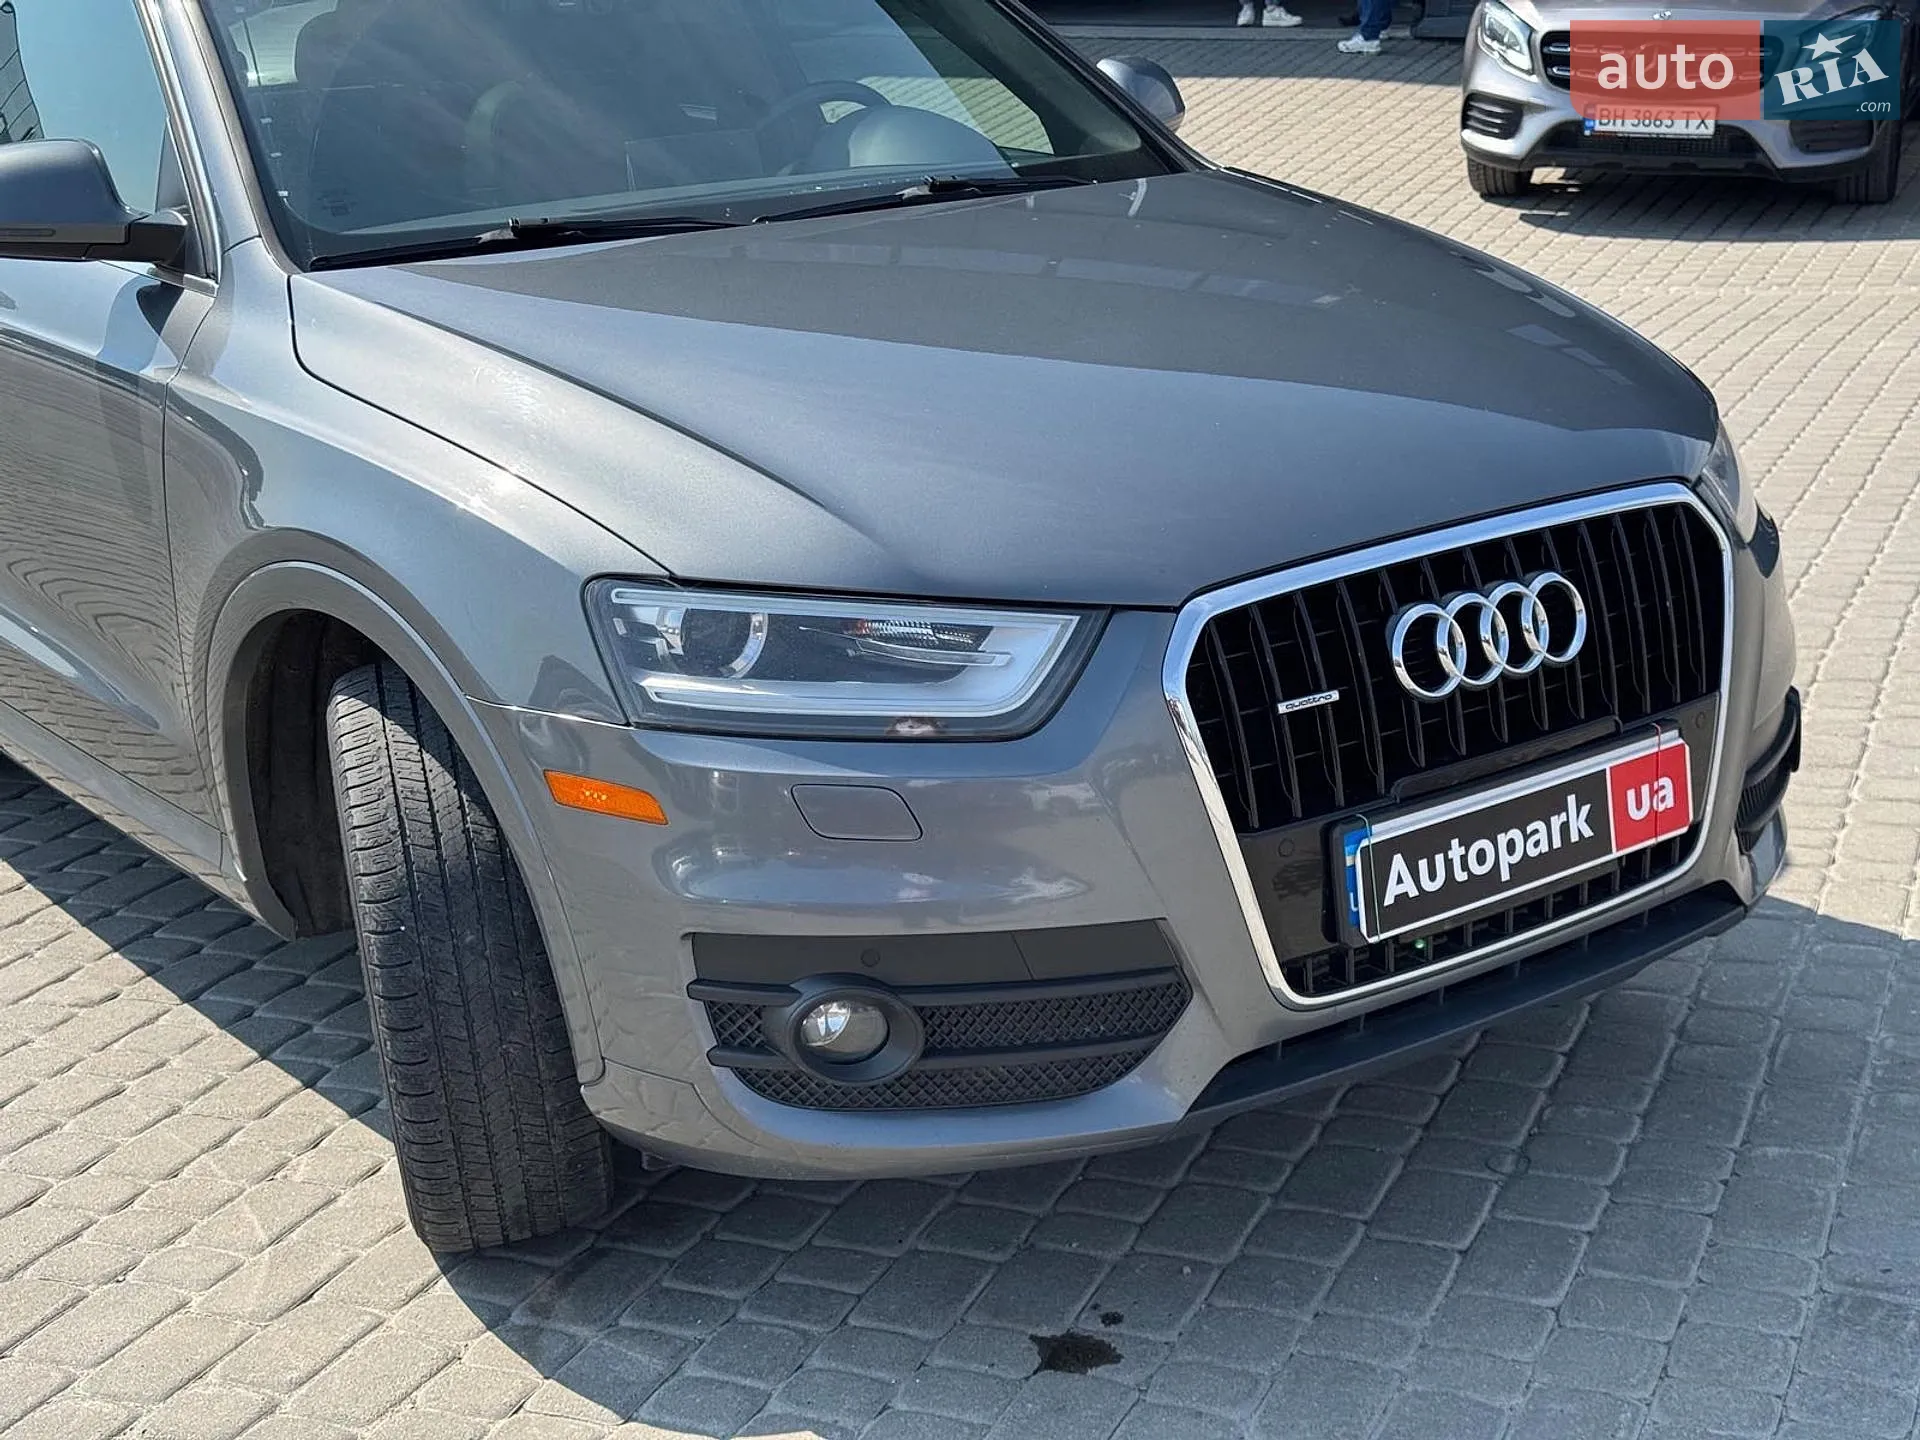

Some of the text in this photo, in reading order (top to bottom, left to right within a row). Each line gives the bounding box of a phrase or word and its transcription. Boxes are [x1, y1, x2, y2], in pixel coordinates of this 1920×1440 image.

[1285, 694, 1332, 710] quattro
[1383, 776, 1675, 907] Autopark ua
